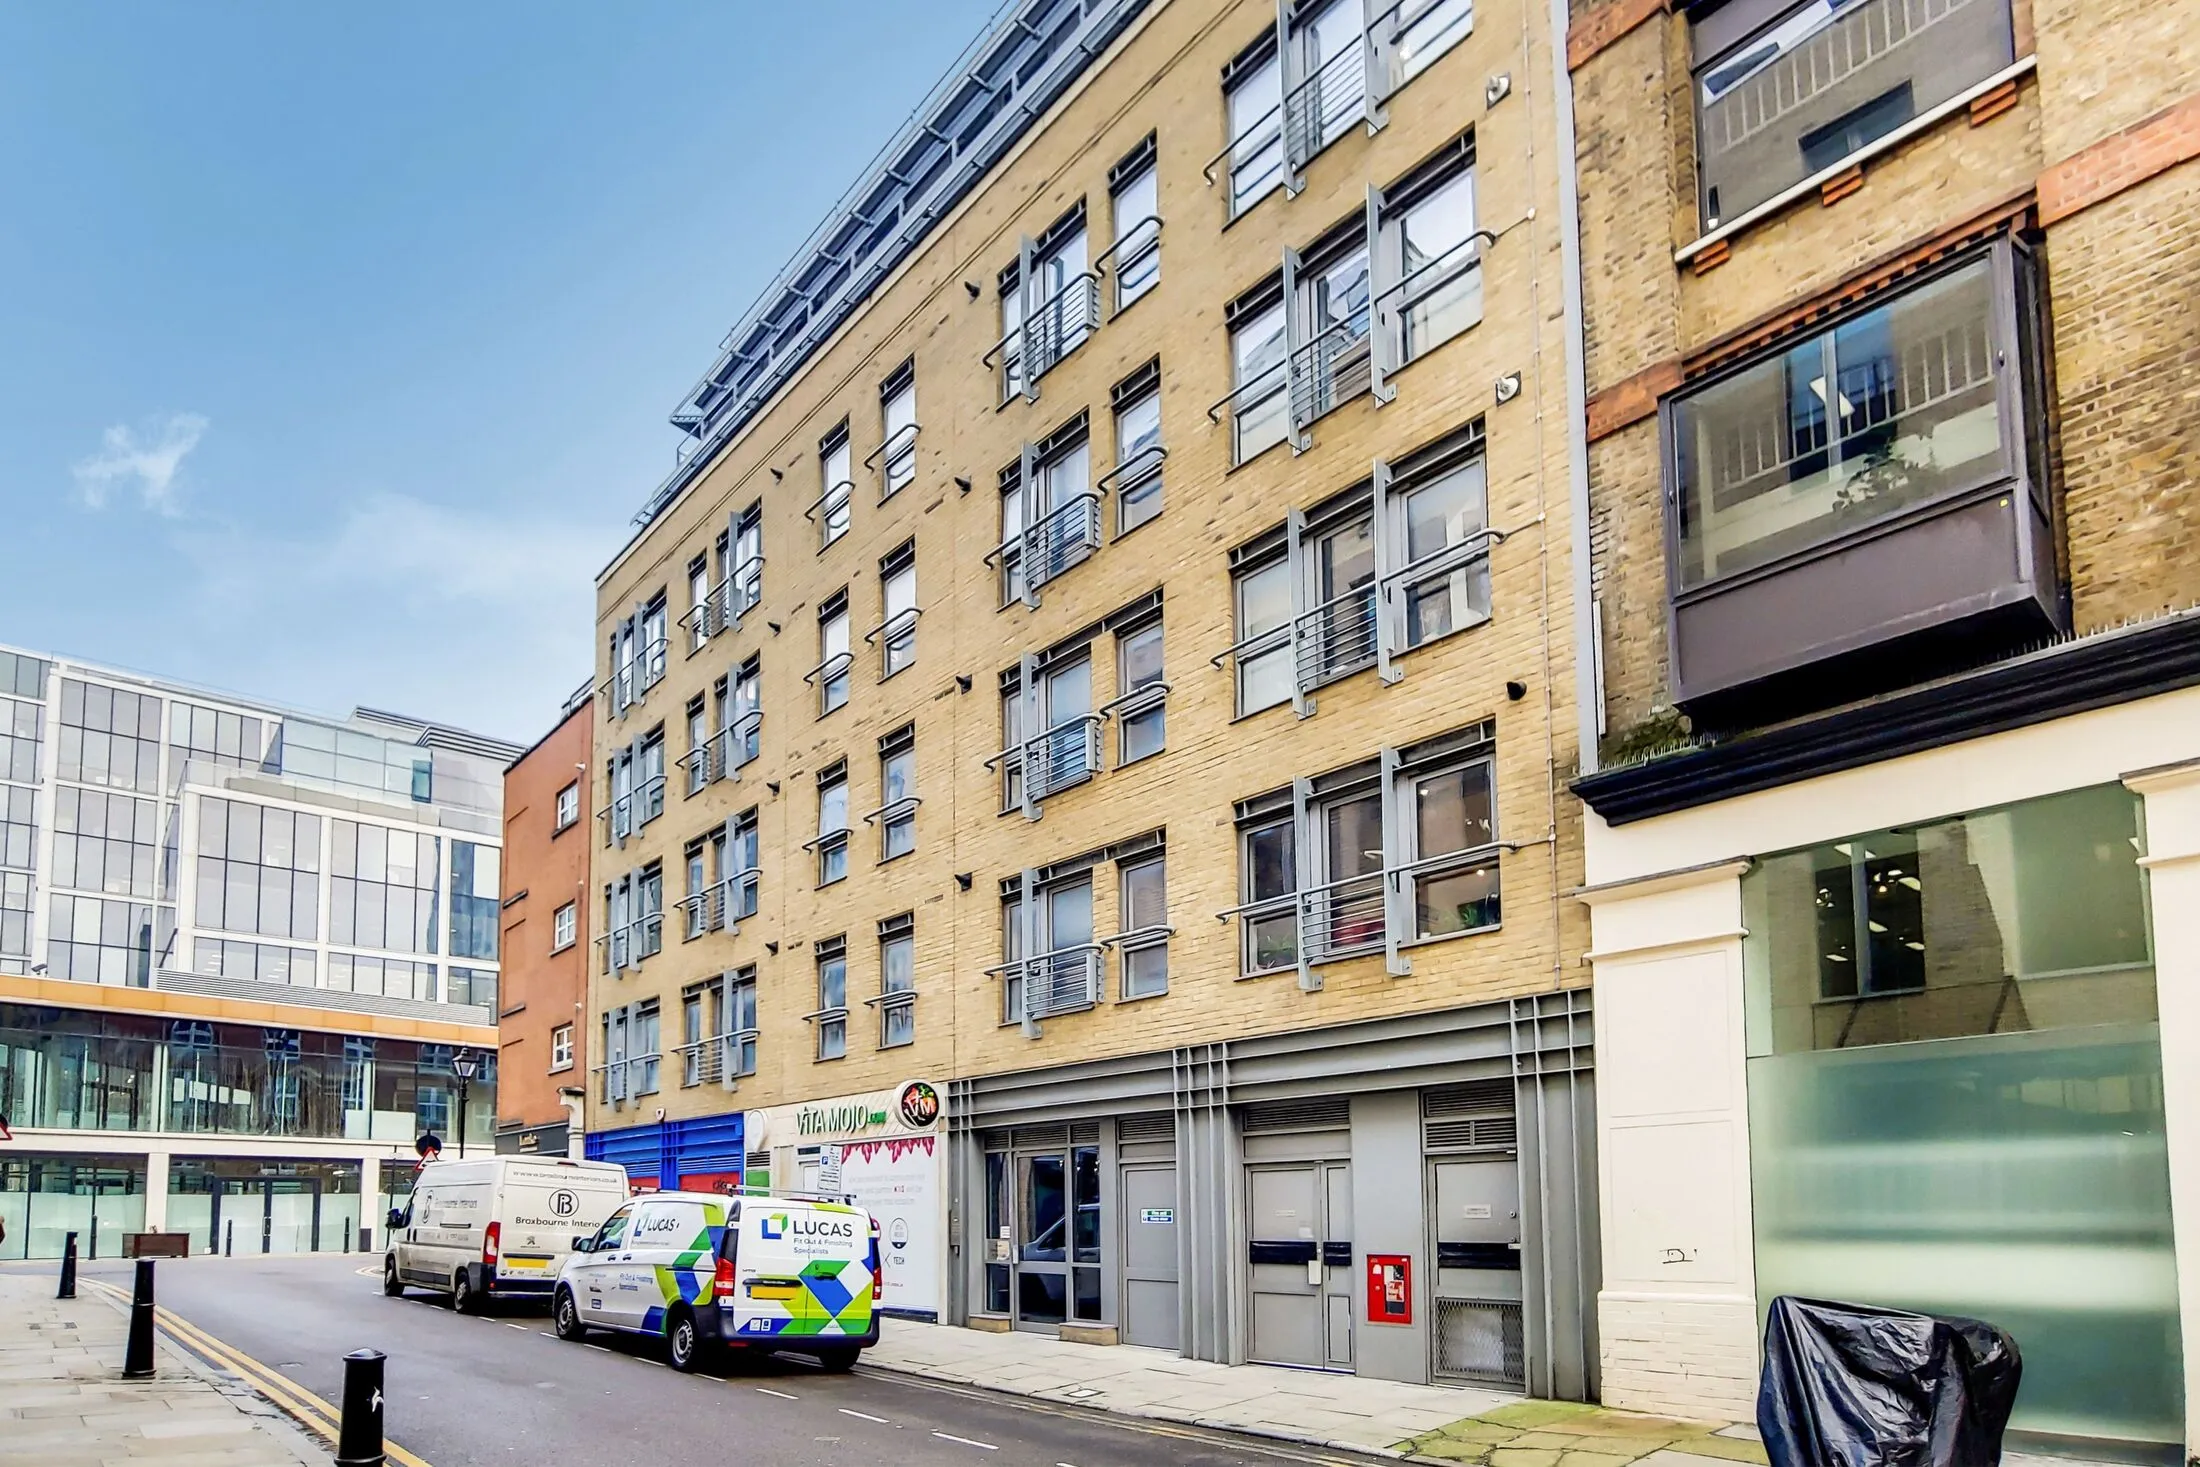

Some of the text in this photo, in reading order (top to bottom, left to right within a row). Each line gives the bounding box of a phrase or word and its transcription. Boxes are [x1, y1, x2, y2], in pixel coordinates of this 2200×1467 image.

[515, 1216, 569, 1227] Broxbourne
[647, 1218, 676, 1231] LUCAS
[793, 1220, 853, 1237] LUCAS
[824, 1239, 853, 1248] Finishing
[793, 1246, 829, 1255] Specialists
